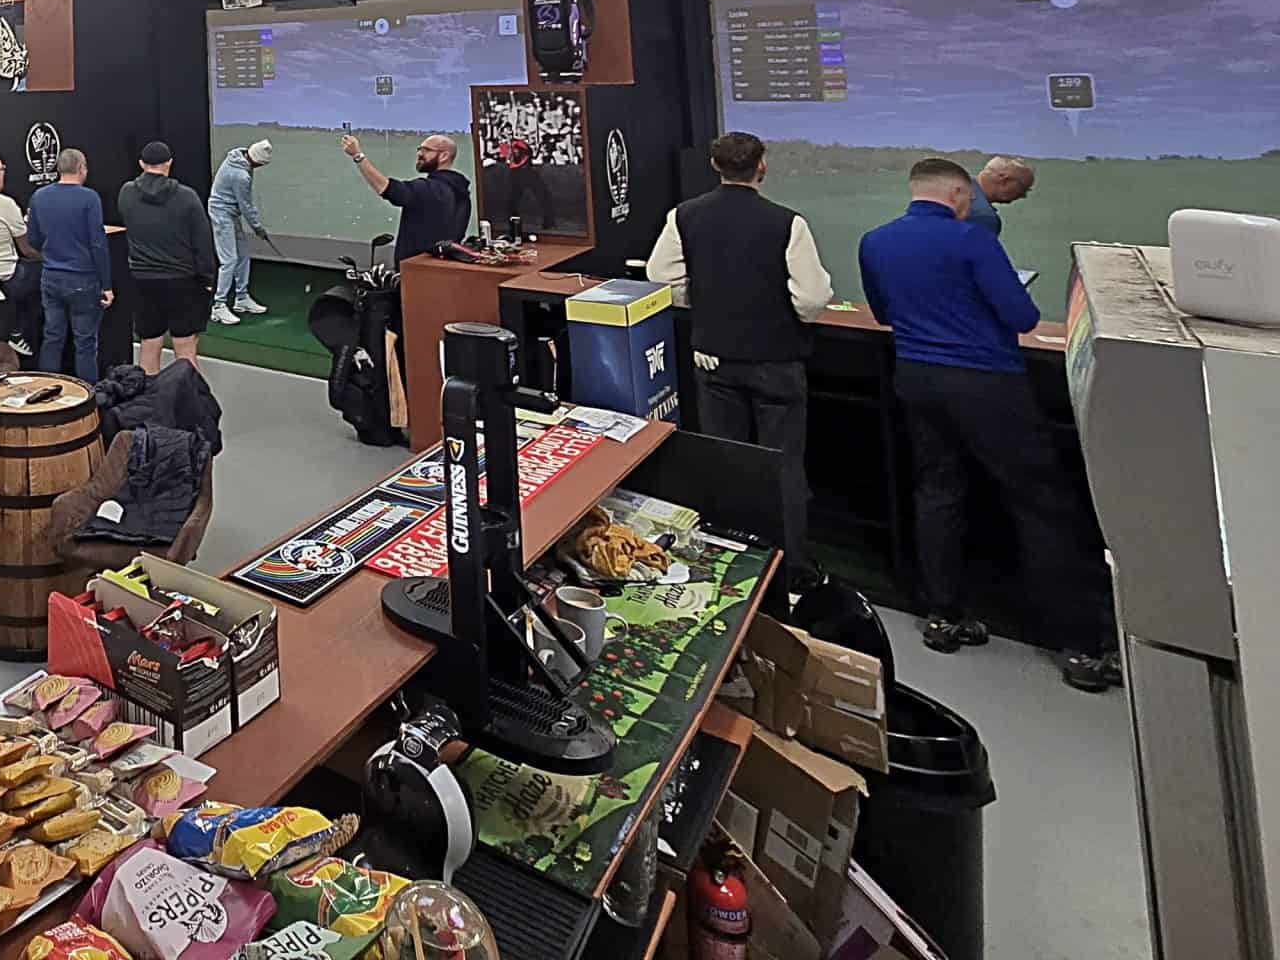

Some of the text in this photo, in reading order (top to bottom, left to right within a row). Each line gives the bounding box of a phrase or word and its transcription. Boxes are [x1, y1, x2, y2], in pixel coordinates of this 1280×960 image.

[451, 463, 469, 554] GUINNESS
[127, 649, 160, 672] Mars
[477, 760, 519, 810] THATCHE
[148, 876, 215, 929] PIPERS
[705, 906, 748, 920] OWDER
[261, 925, 322, 957] PIPER
